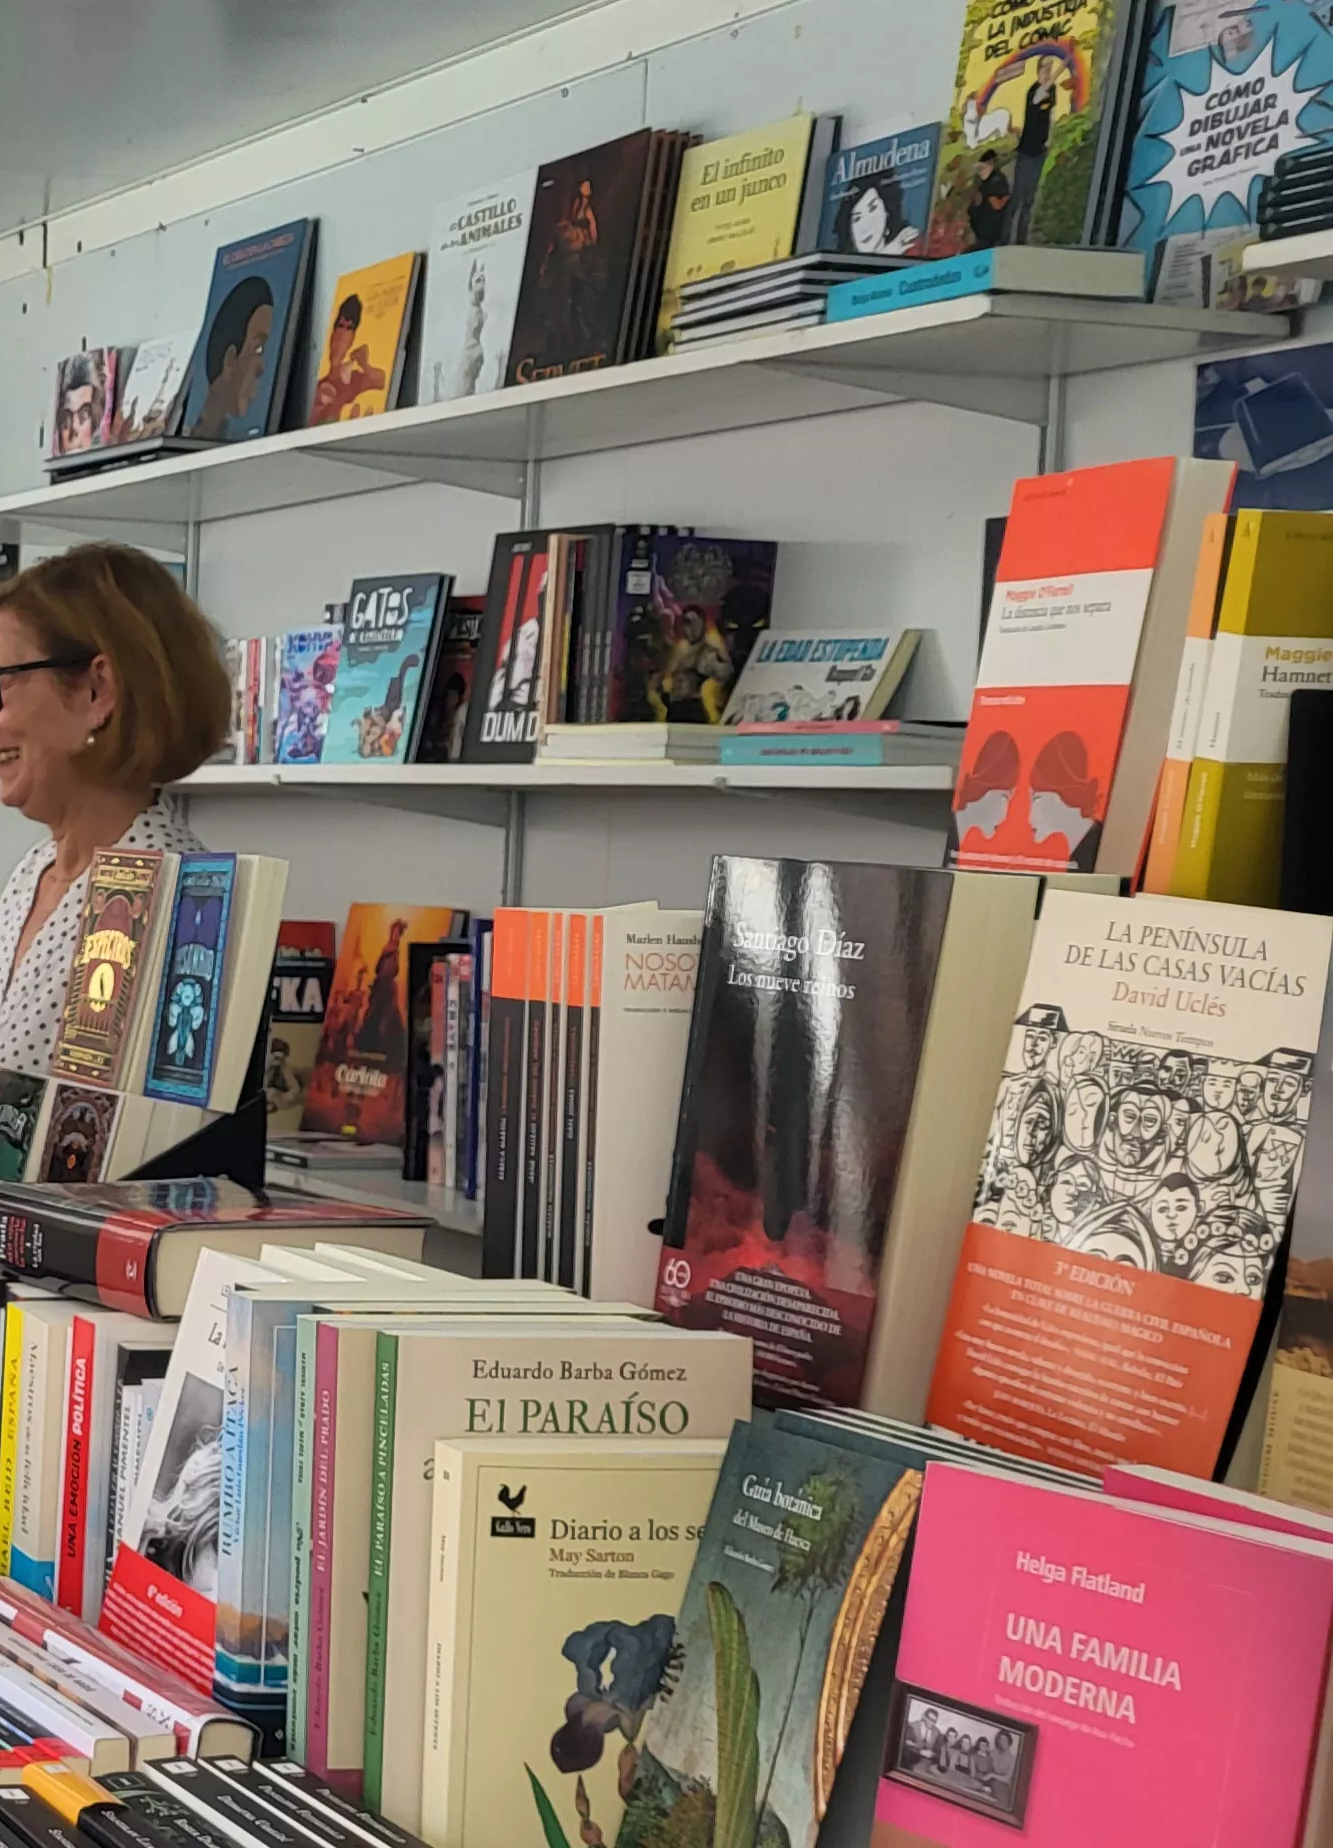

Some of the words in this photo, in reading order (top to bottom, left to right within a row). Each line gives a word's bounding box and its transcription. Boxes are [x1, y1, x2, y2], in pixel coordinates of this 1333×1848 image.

[985, 39, 1014, 62] DEL
[1204, 77, 1266, 112] CÓMO
[1188, 94, 1278, 138] DIBUJAR
[1204, 110, 1290, 153] NOVELA
[701, 163, 721, 186] El
[723, 147, 785, 181] infinito
[832, 137, 932, 185] Almudena
[1187, 133, 1281, 178] GRÁFICA
[690, 194, 711, 212] en
[714, 187, 737, 207] un
[738, 172, 788, 204] junco
[458, 198, 517, 231] CASTILLO
[461, 212, 523, 246] ANIMALES
[352, 586, 415, 630] GATOS
[1261, 665, 1332, 684] Hamnet
[1265, 645, 1333, 663] Maggie
[665, 932, 703, 946] Haush
[732, 921, 811, 963] Santiago
[816, 928, 865, 962] Díaz
[1105, 920, 1132, 944] LA
[1137, 924, 1268, 962] PENÍNSULA
[727, 962, 757, 988] Los
[757, 969, 802, 995] nueve
[803, 971, 857, 1001] reinos
[1063, 944, 1094, 967] DE
[1097, 948, 1138, 973] LAS
[1142, 954, 1213, 983] CASAS
[1219, 965, 1308, 998] VACÍAS
[1111, 981, 1171, 1009] David
[1175, 989, 1228, 1018] Uclés
[1069, 1264, 1137, 1298] EDICIÓN
[472, 1358, 554, 1381] Eduardo
[560, 1359, 614, 1382] Barba
[619, 1357, 687, 1383] Gómez
[6, 1356, 19, 1442] ESPAÑA
[71, 1357, 88, 1437] POLÍTICA
[319, 1388, 333, 1447] PRADO
[377, 1361, 392, 1468] PINCELADAS
[518, 1392, 690, 1436] PARAÍSO
[67, 1439, 83, 1519] EMOCIÓN
[318, 1449, 331, 1486] DEL
[221, 1470, 236, 1557] RUMBO
[375, 1483, 389, 1553] PARAÍSO
[741, 1472, 772, 1502] Guía
[773, 1482, 824, 1522] botánica
[65, 1521, 78, 1558] UNA
[315, 1491, 330, 1549] JARDÍN
[550, 1518, 623, 1542] Diario
[628, 1525, 642, 1541] a
[647, 1518, 681, 1542] los
[732, 1507, 748, 1527] del
[773, 1522, 786, 1542] de
[549, 1547, 582, 1567] May
[586, 1547, 635, 1564] Sarton
[603, 1567, 616, 1579] de
[1015, 1550, 1066, 1585] Helga
[1070, 1563, 1147, 1605] Flatland
[1006, 1611, 1064, 1656] UNA
[1069, 1633, 1183, 1693] FAMILIA
[998, 1654, 1137, 1725] MODERNA
